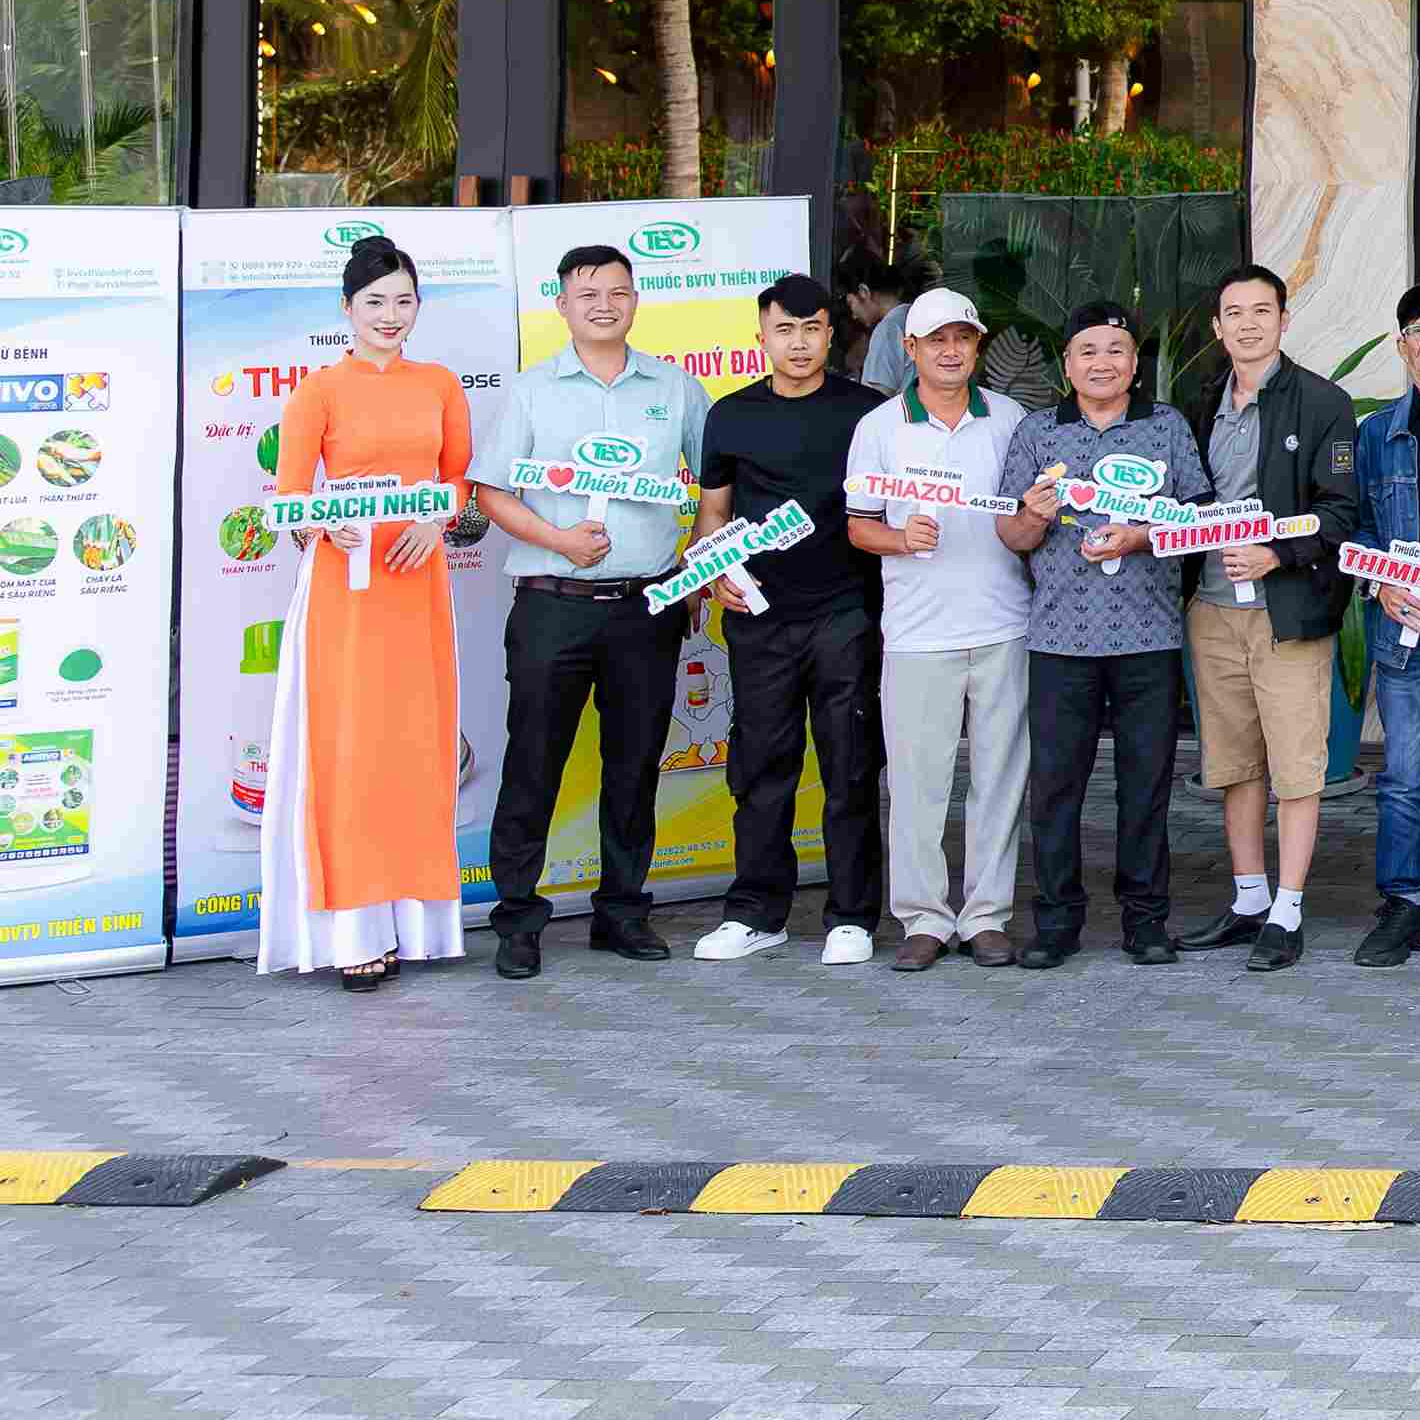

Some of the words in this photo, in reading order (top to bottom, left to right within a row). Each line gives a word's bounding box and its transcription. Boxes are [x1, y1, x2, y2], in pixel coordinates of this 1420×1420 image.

[639, 269, 681, 291] THUỐC
[687, 272, 716, 288] BVTV
[721, 268, 759, 287] THIÊN
[309, 331, 349, 347] THUỐC
[684, 346, 723, 379] QUÝ
[2, 380, 59, 404] IVO
[514, 463, 545, 485] Tôi
[575, 469, 628, 495] Thiên
[634, 476, 684, 502] Bình
[866, 475, 967, 507] THIAZOL
[273, 500, 304, 525] TB
[311, 494, 377, 525] SẠCH
[383, 486, 450, 516] NHỆN
[1096, 490, 1148, 517] Thiên
[1152, 499, 1196, 524] Bình
[1155, 515, 1269, 552] THIMIDA
[648, 542, 744, 611] Azobin
[741, 505, 806, 551] Gold
